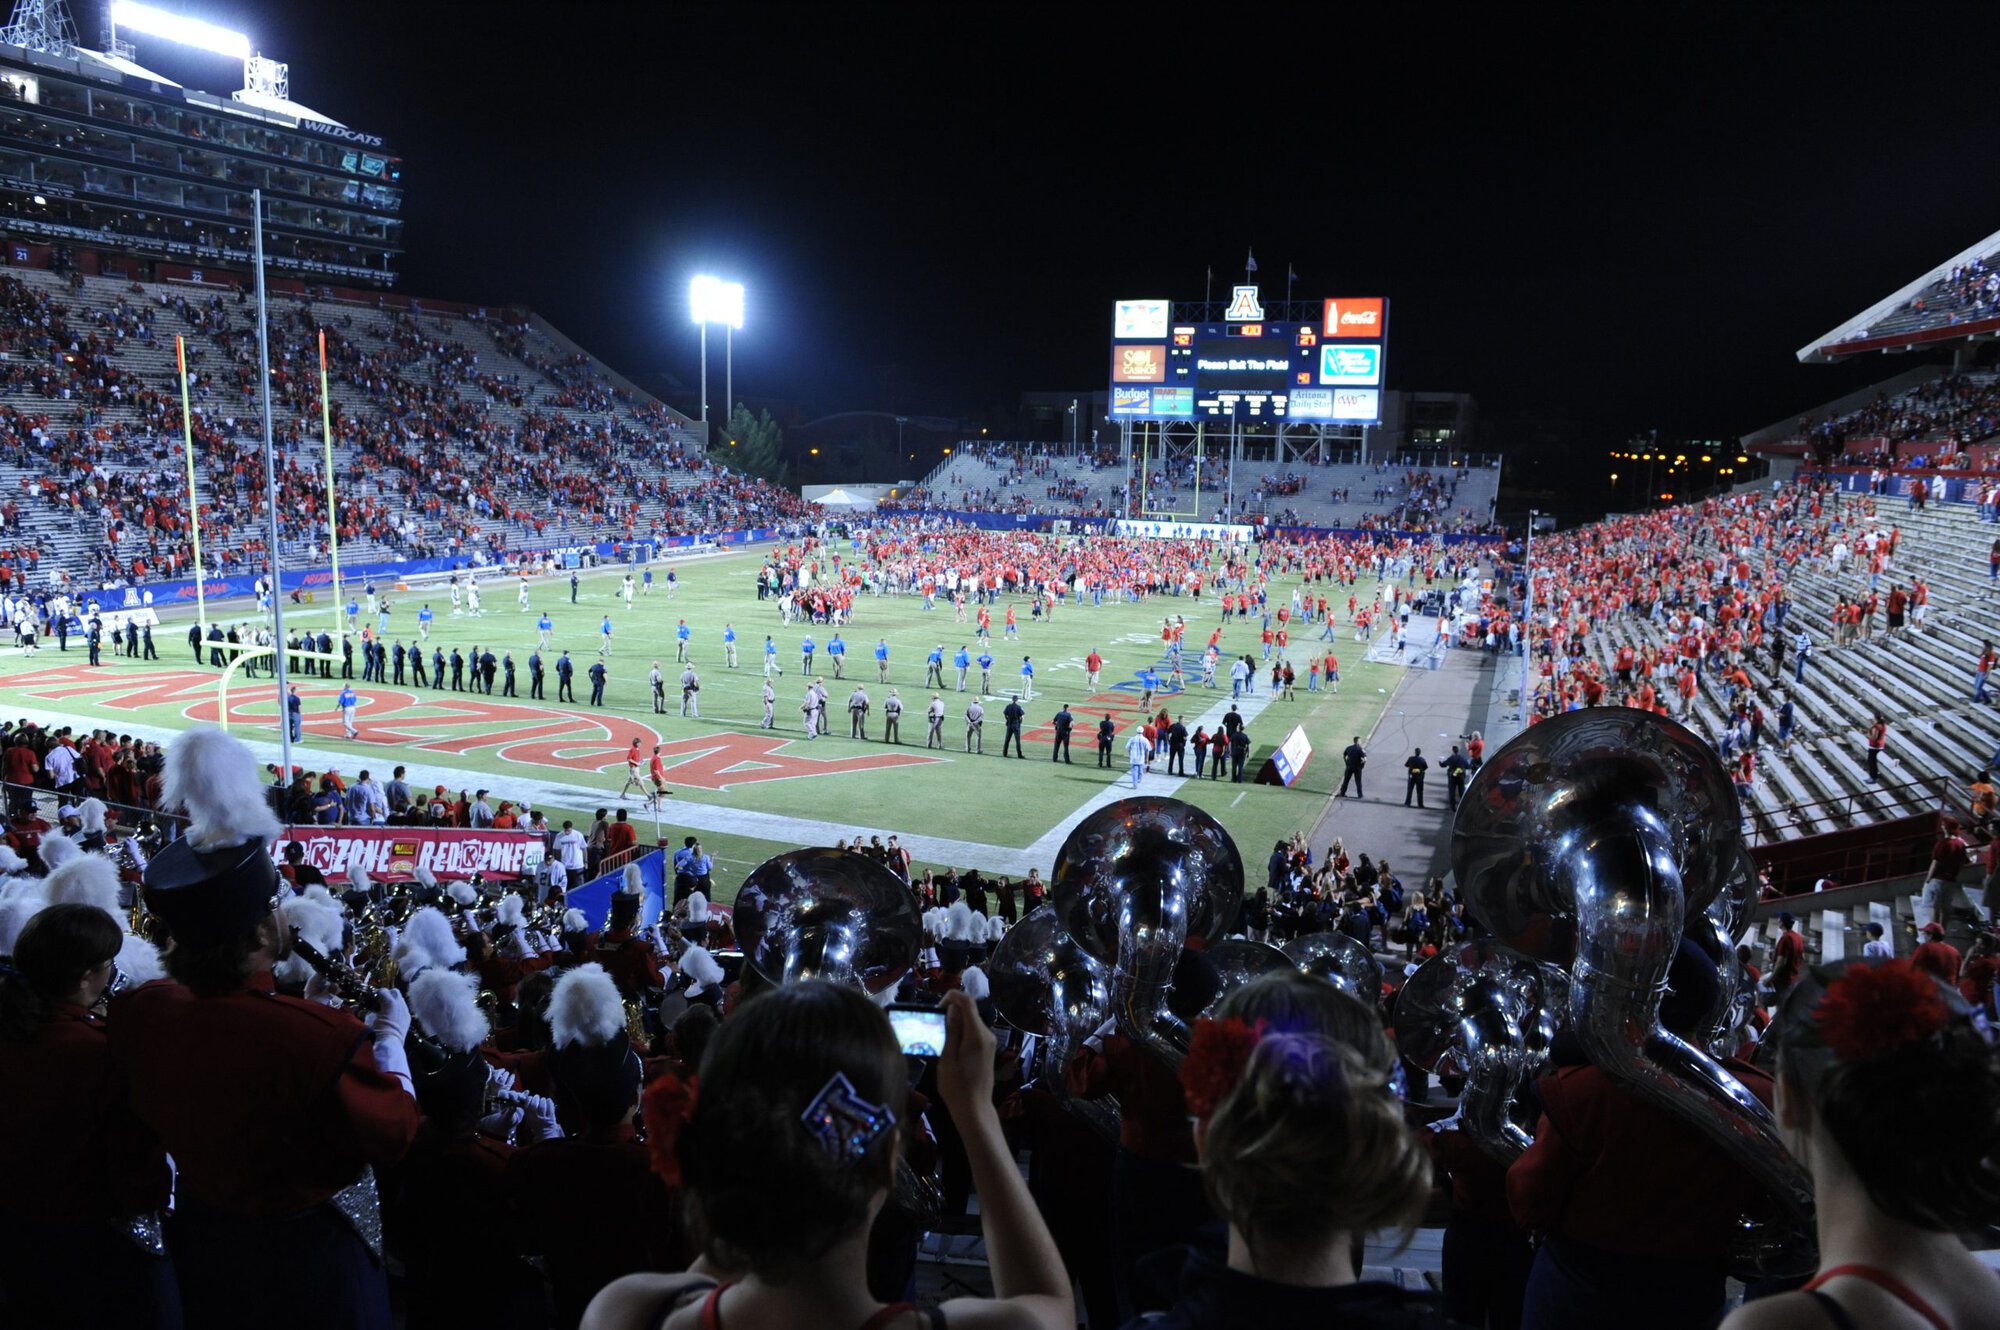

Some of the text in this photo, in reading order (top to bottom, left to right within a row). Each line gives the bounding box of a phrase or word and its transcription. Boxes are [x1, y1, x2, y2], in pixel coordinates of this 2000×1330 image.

[304, 119, 383, 147] WILDCATS
[16, 251, 28, 261] 21
[192, 273, 203, 283] 22
[1225, 286, 1264, 320] A
[1300, 335, 1315, 345] 27
[1123, 350, 1156, 367] SOL
[1123, 365, 1157, 375] CASINOS
[1198, 360, 1289, 370] Please Exit The Field
[1114, 387, 1150, 402] Budget
[1295, 391, 1327, 399] Arizona
[1290, 400, 1312, 410] Daily
[1314, 400, 1331, 408] Star
[124, 588, 142, 607] A
[333, 838, 394, 873] ZONE
[418, 841, 461, 872] RED
[478, 842, 526, 872] ZONE
